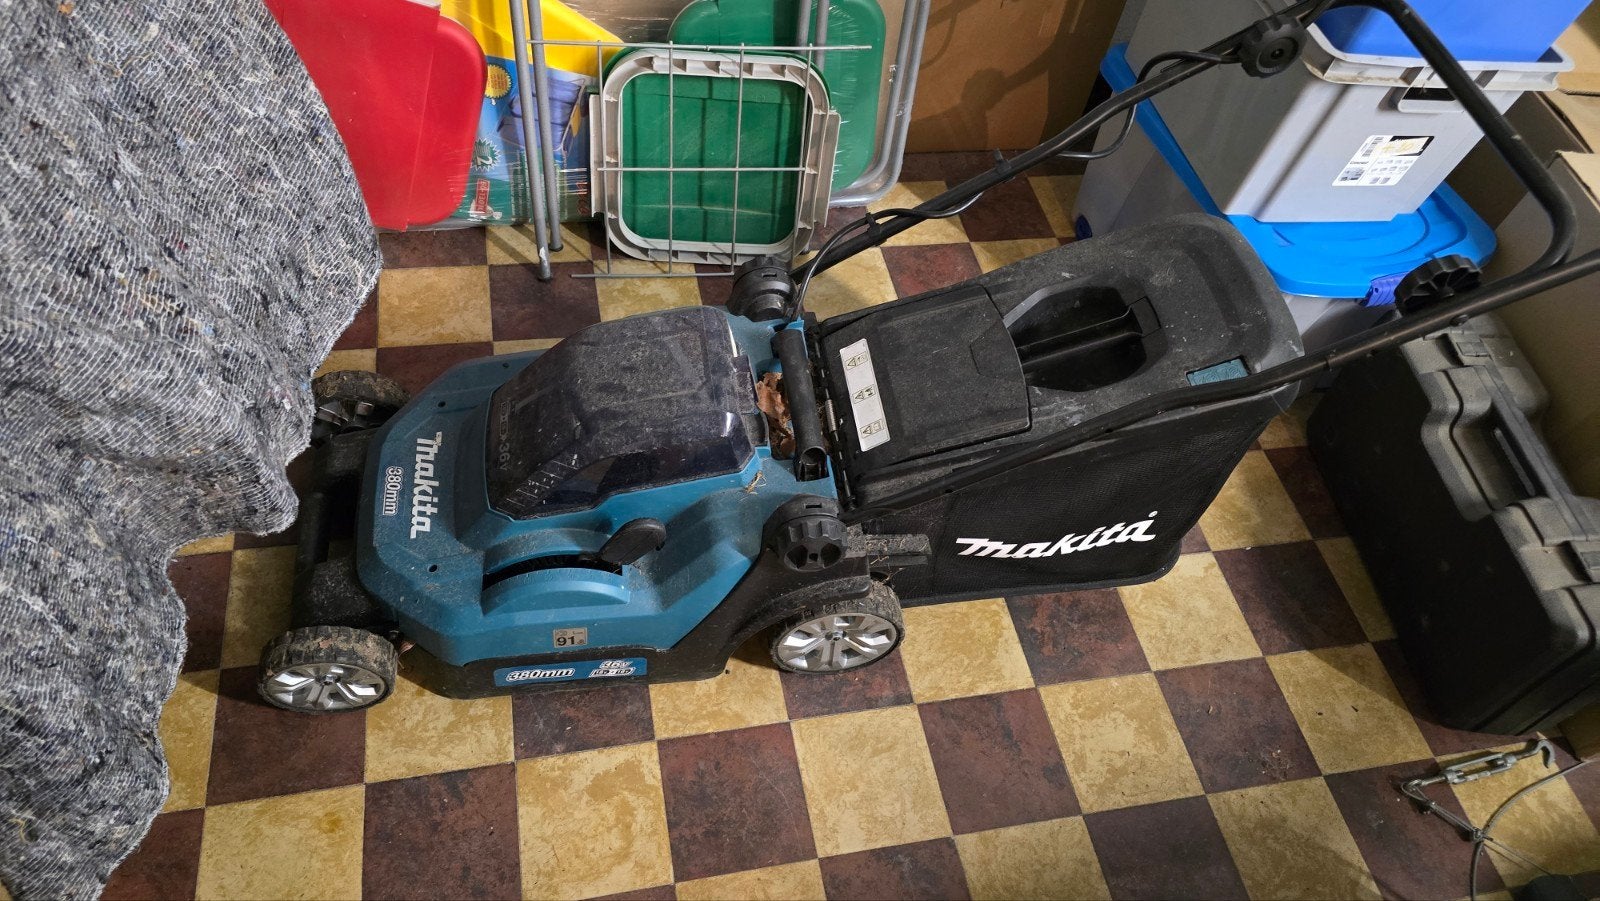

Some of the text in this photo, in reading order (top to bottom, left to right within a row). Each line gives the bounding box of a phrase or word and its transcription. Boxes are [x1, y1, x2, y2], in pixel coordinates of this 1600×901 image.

[384, 466, 403, 516] 380mm
[557, 636, 575, 646] 91
[506, 668, 575, 682] 380mm
